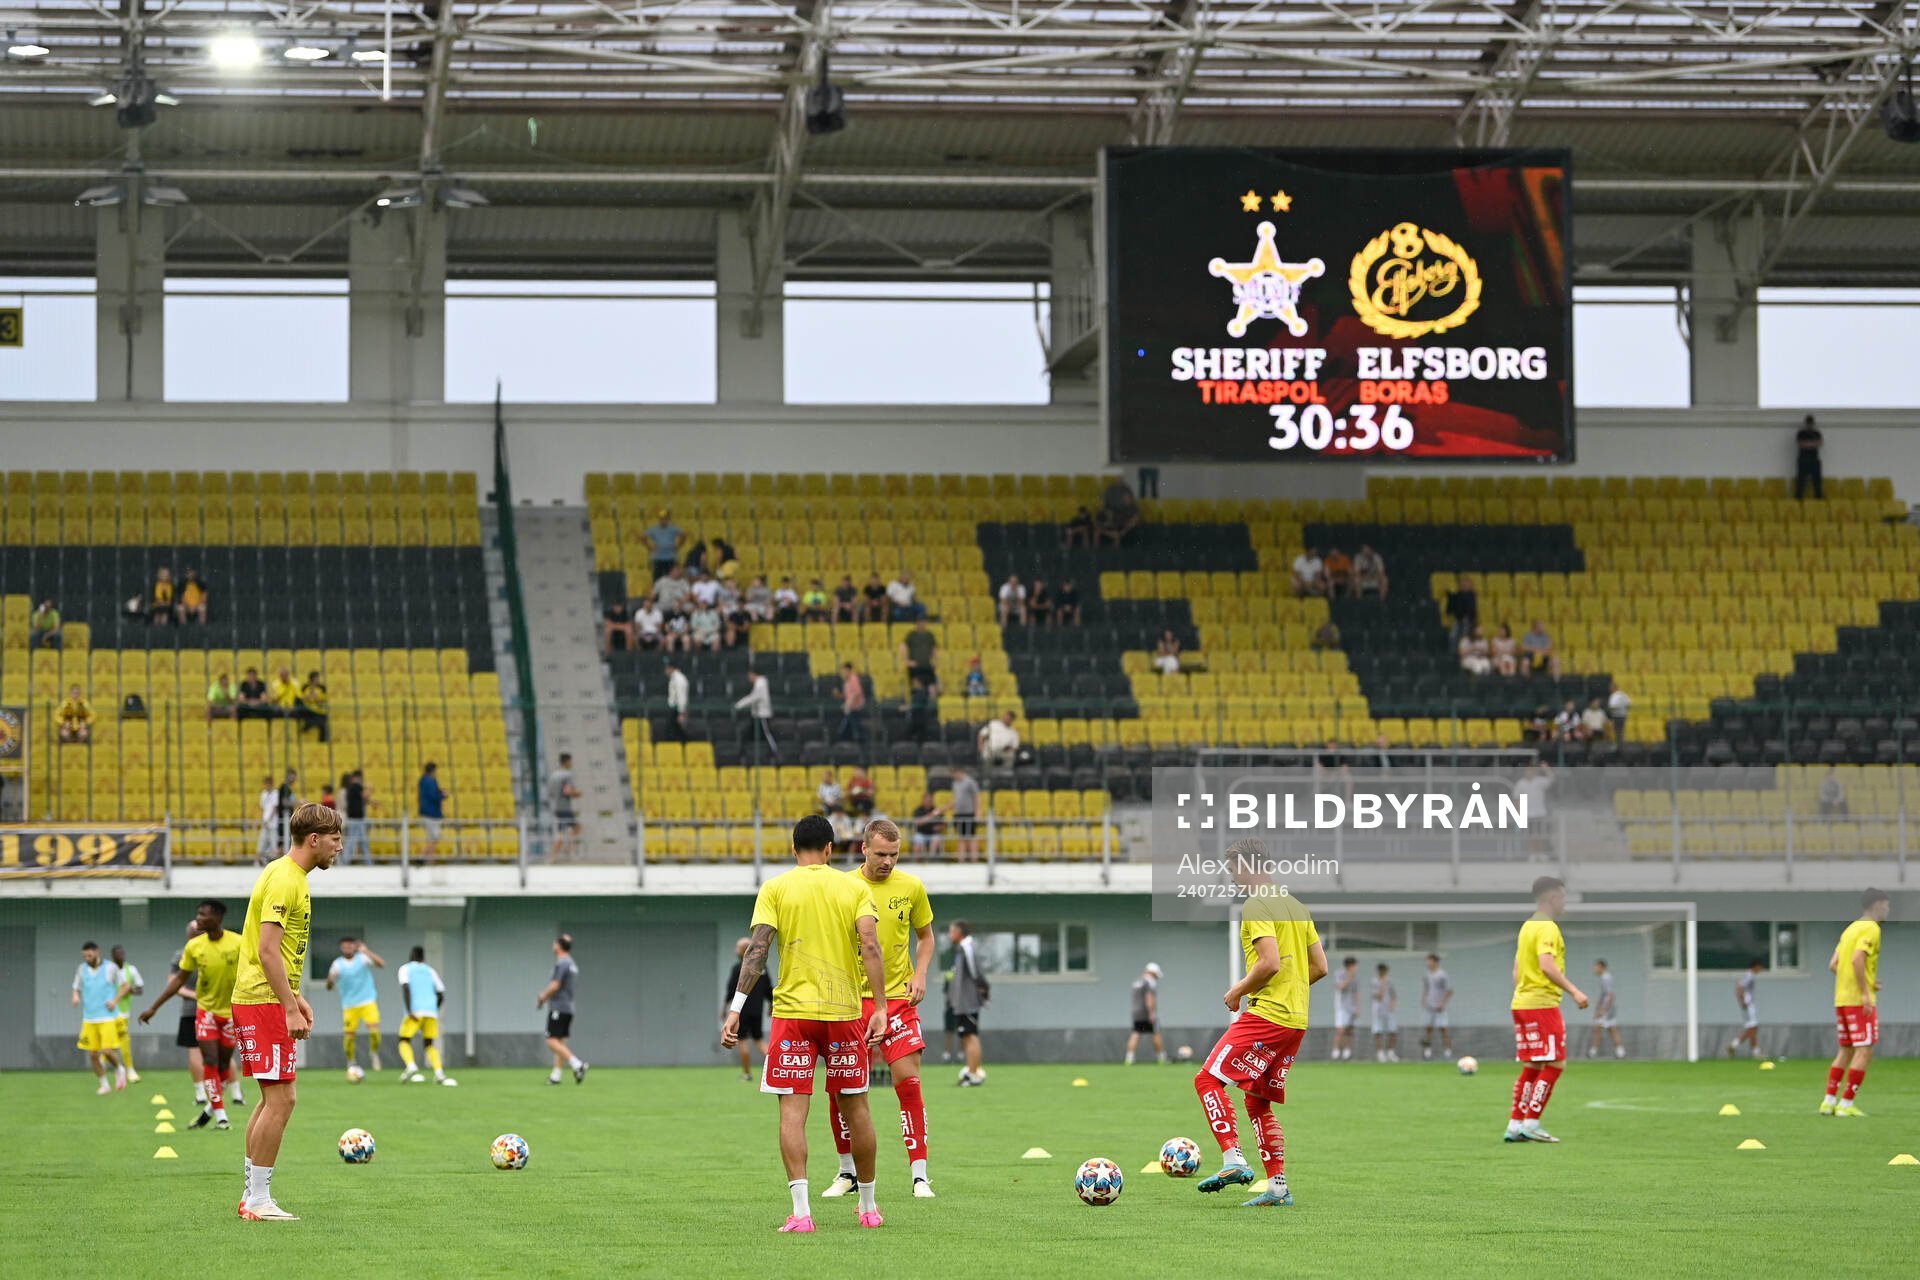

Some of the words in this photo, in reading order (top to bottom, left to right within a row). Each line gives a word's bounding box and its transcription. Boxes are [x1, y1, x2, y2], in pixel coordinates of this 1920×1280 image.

[1, 316, 17, 340] 3
[1171, 347, 1327, 380] SHERIFF
[1356, 346, 1548, 380] ELFSBORG
[1198, 380, 1326, 405] TIRASPOL
[1360, 380, 1449, 405] BORAS
[1268, 404, 1414, 450] 30:36
[0, 832, 158, 867] 1997
[898, 910, 904, 922] 4
[782, 1055, 810, 1067] EAB
[830, 1054, 856, 1066] EAB
[1244, 1052, 1267, 1071] EAB
[772, 1067, 813, 1079] Cernera
[827, 1067, 861, 1079] ernera
